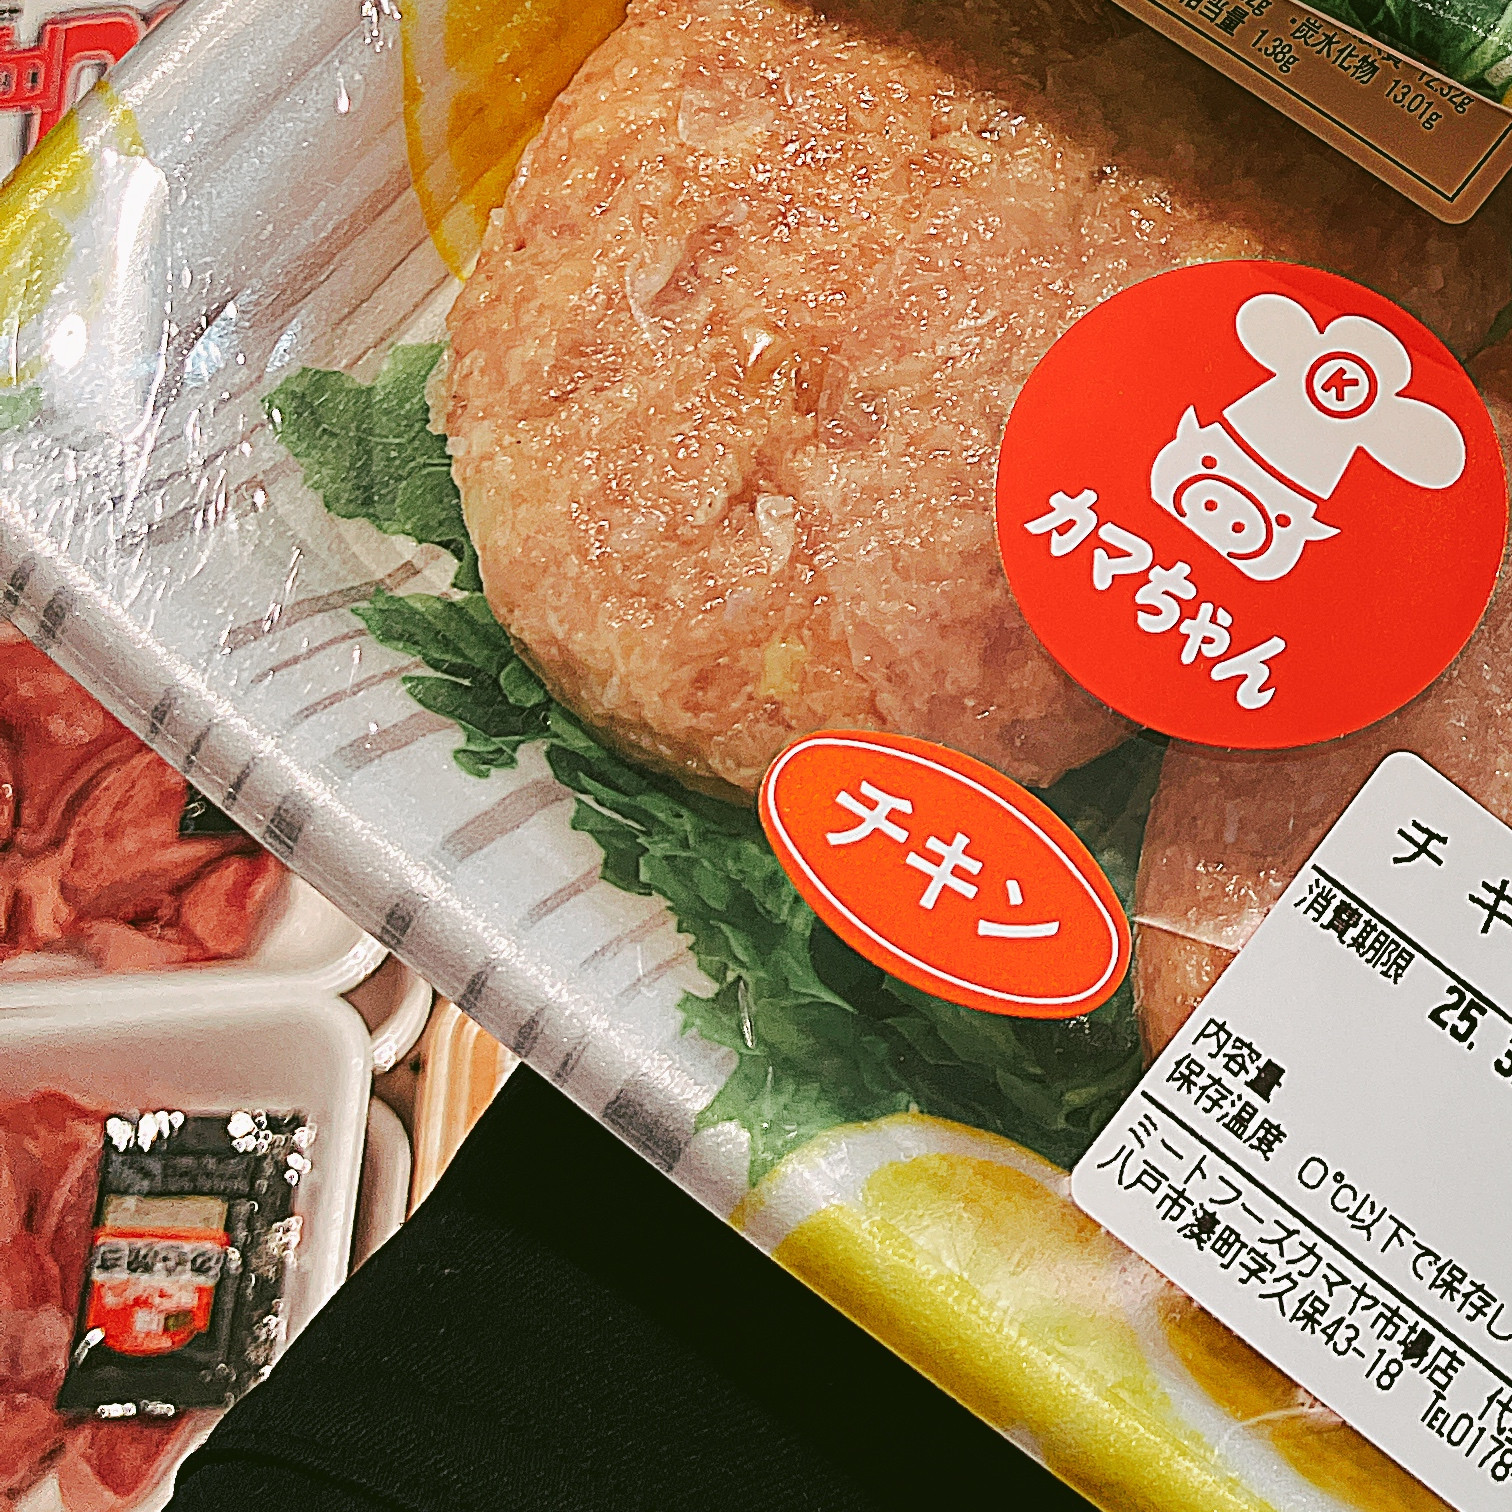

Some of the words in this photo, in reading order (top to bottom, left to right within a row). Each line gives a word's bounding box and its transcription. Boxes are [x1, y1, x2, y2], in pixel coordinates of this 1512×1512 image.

[1249, 28, 1300, 75] 1.38g
[1384, 78, 1444, 131] 13.01g
[1321, 366, 1360, 402] K
[1024, 488, 1287, 710] カマちゃん
[825, 780, 1061, 939] チキン
[1293, 877, 1416, 985] 消費期限
[1165, 1052, 1288, 1162] 保存温度
[1188, 1017, 1286, 1104] 内容量
[1096, 1144, 1404, 1391] 八戸市湊町字久保43-18
[1127, 1113, 1466, 1393] ミートフーズカマヤ市場店
